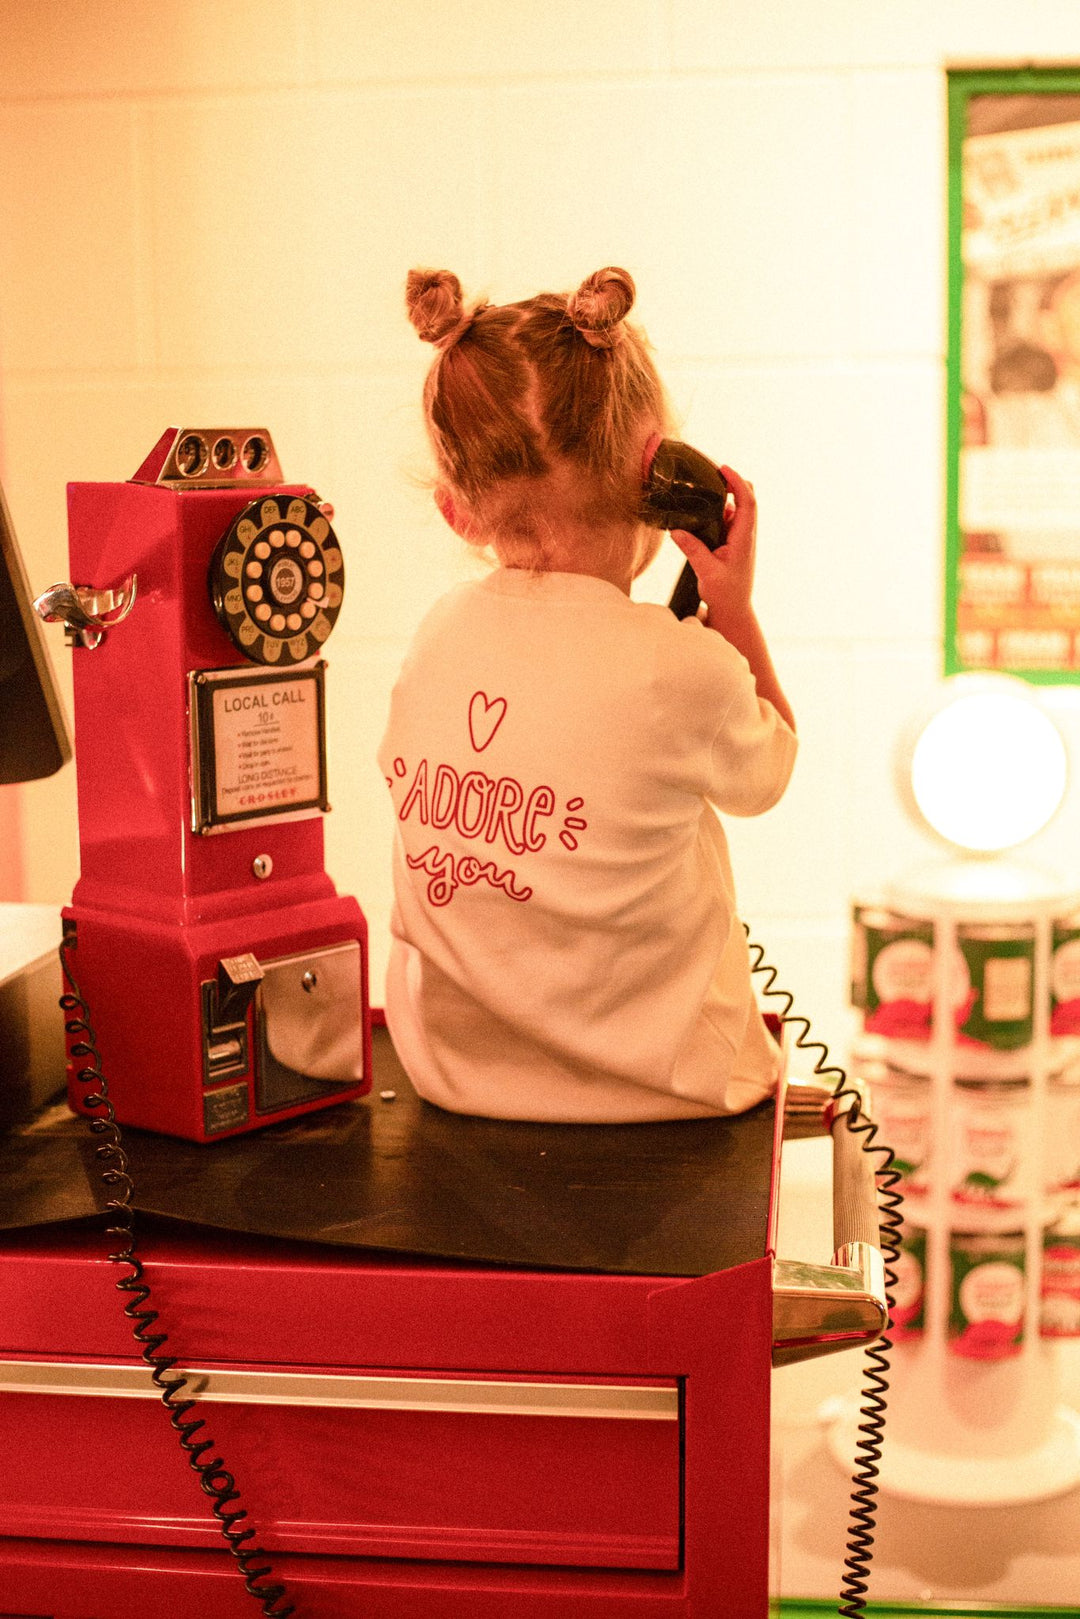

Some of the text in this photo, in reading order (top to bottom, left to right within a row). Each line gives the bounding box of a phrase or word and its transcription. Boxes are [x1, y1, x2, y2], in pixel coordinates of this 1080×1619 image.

[290, 505, 305, 513] ABC
[276, 577, 295, 588] 1957
[224, 689, 305, 713] LOCAL CALL
[238, 771, 260, 784] LONG
[261, 765, 297, 780] DISTANCE
[406, 845, 533, 907] you
